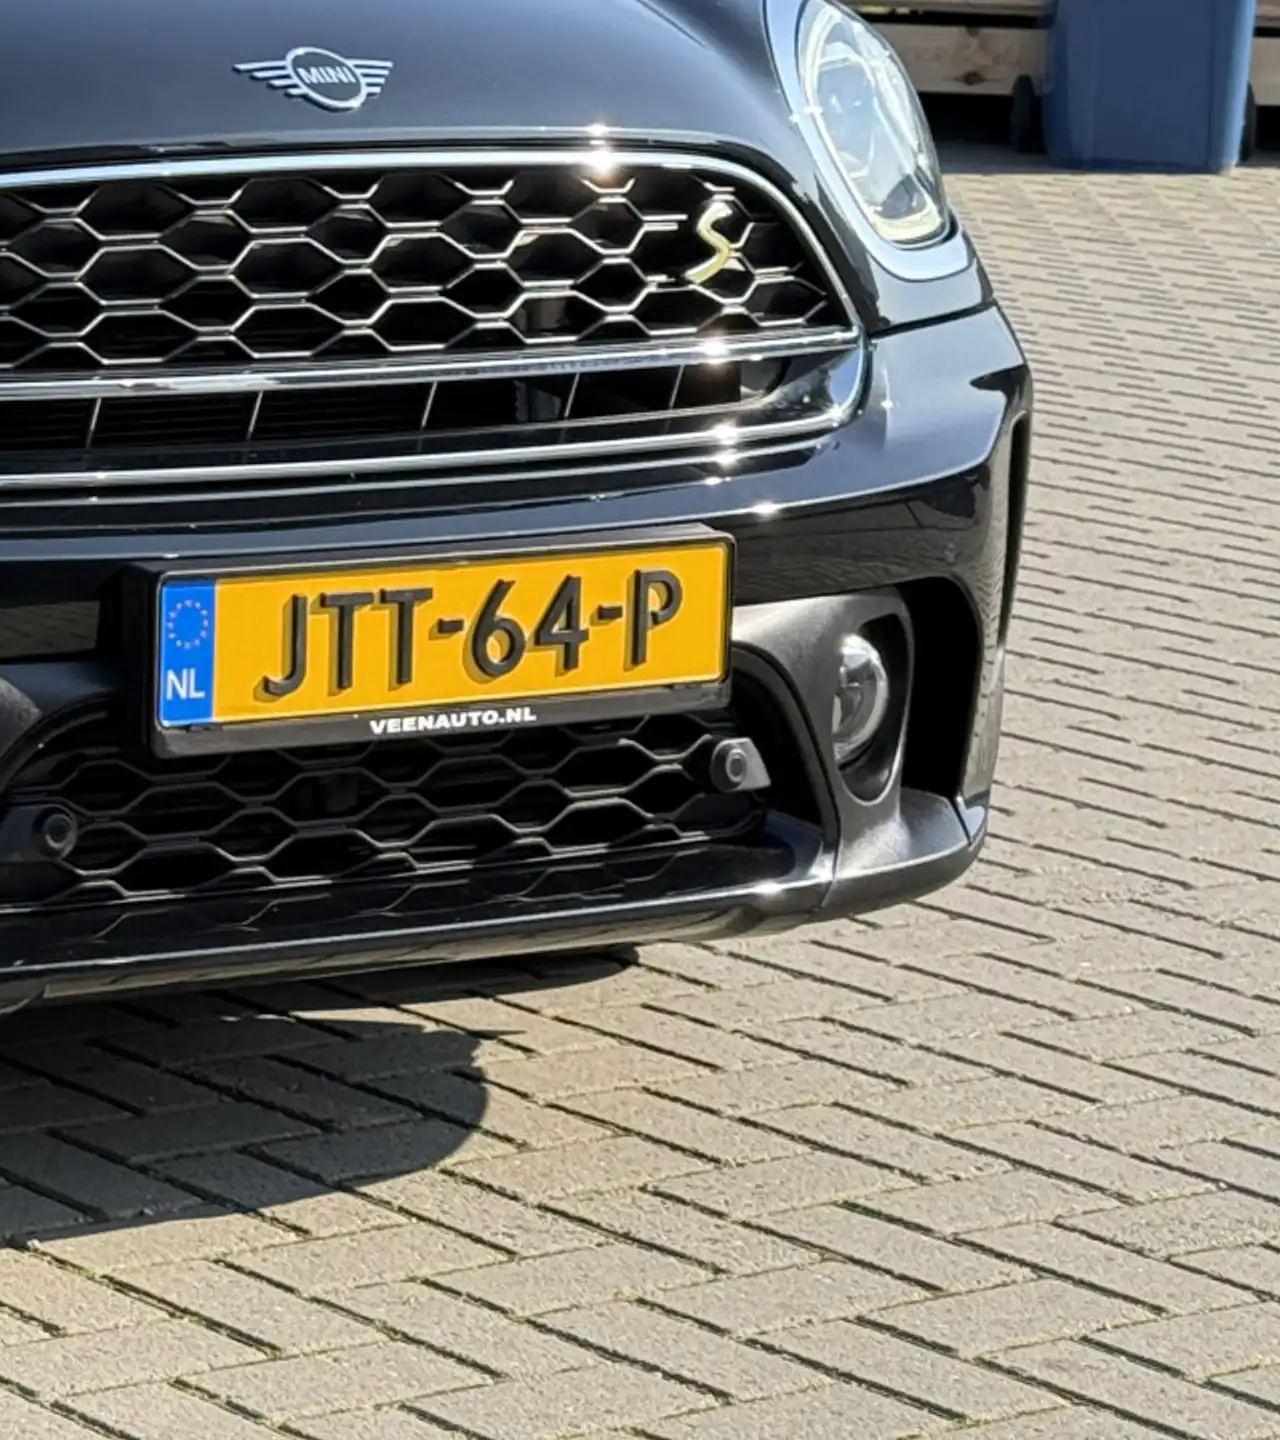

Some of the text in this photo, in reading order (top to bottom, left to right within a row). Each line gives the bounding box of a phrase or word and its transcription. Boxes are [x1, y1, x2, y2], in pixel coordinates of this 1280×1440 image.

[296, 65, 358, 84] MINI
[260, 568, 683, 698] JTT-64-P
[165, 667, 206, 701] NL
[369, 707, 537, 736] VEENAUTO.NL
